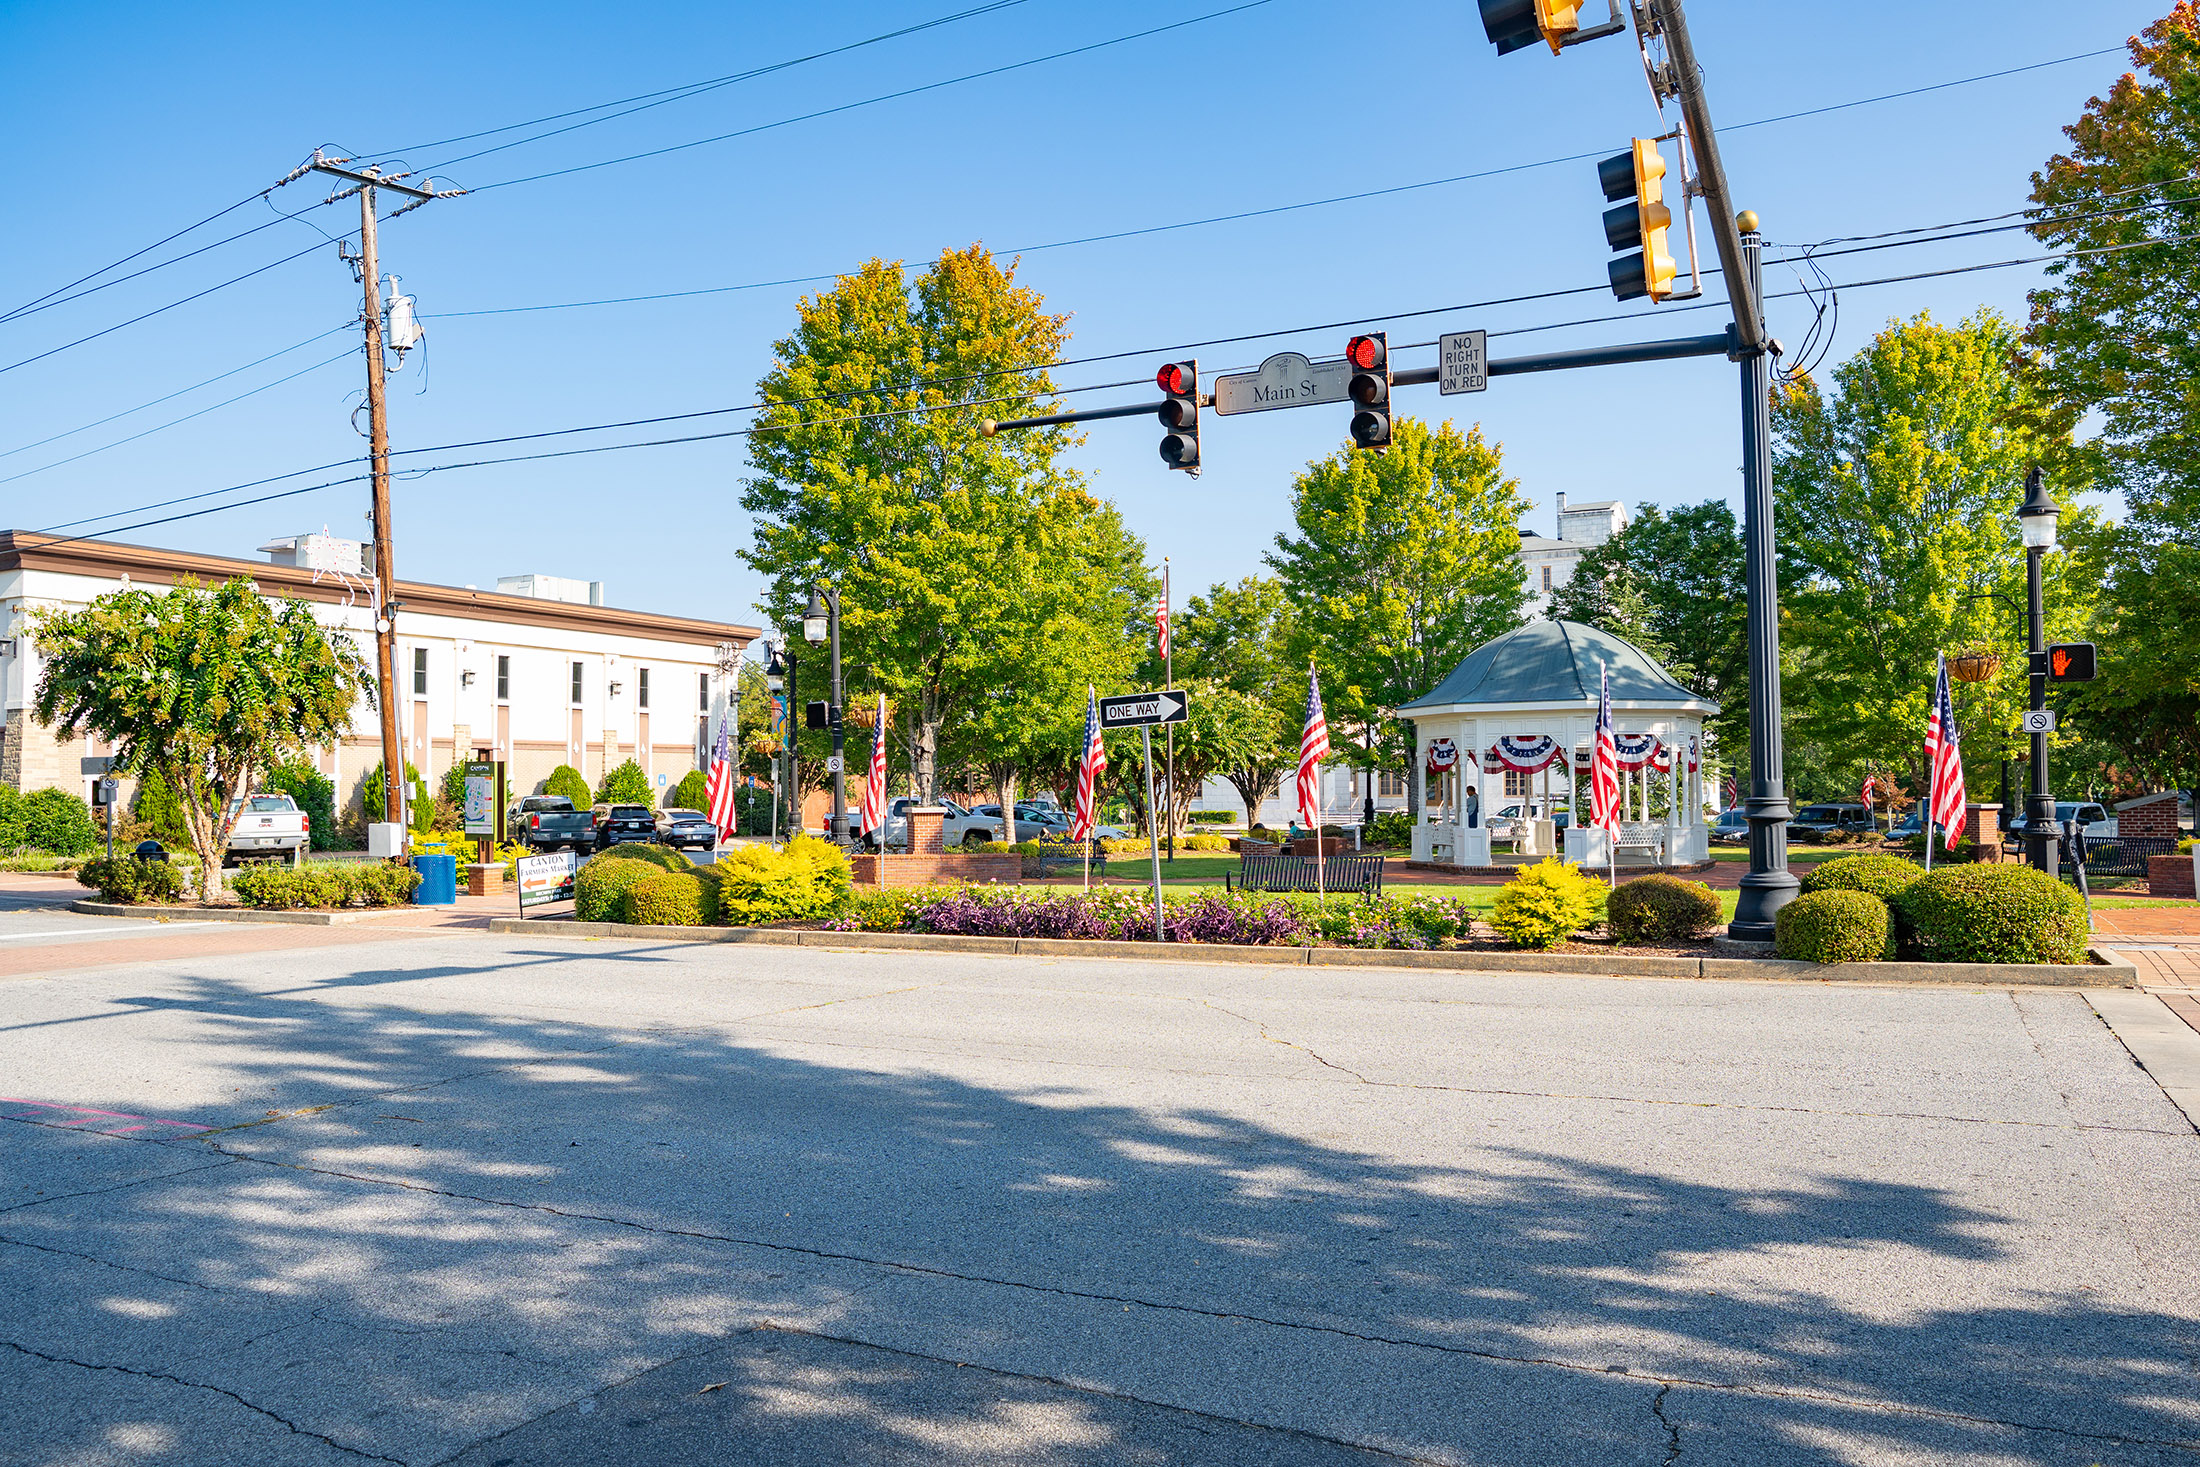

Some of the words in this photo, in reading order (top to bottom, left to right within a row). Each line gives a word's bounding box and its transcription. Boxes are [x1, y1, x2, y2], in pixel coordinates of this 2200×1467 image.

[1453, 337, 1472, 350] NO
[1446, 349, 1480, 364] RIGHT
[1448, 362, 1478, 377] TURN
[1443, 378, 1456, 391] ON
[1463, 375, 1483, 388] RED
[1253, 385, 1295, 403] Main
[1300, 379, 1317, 397] St
[1109, 705, 1133, 719] ONE
[1136, 702, 1160, 716] WAY
[530, 855, 564, 867] CANTON
